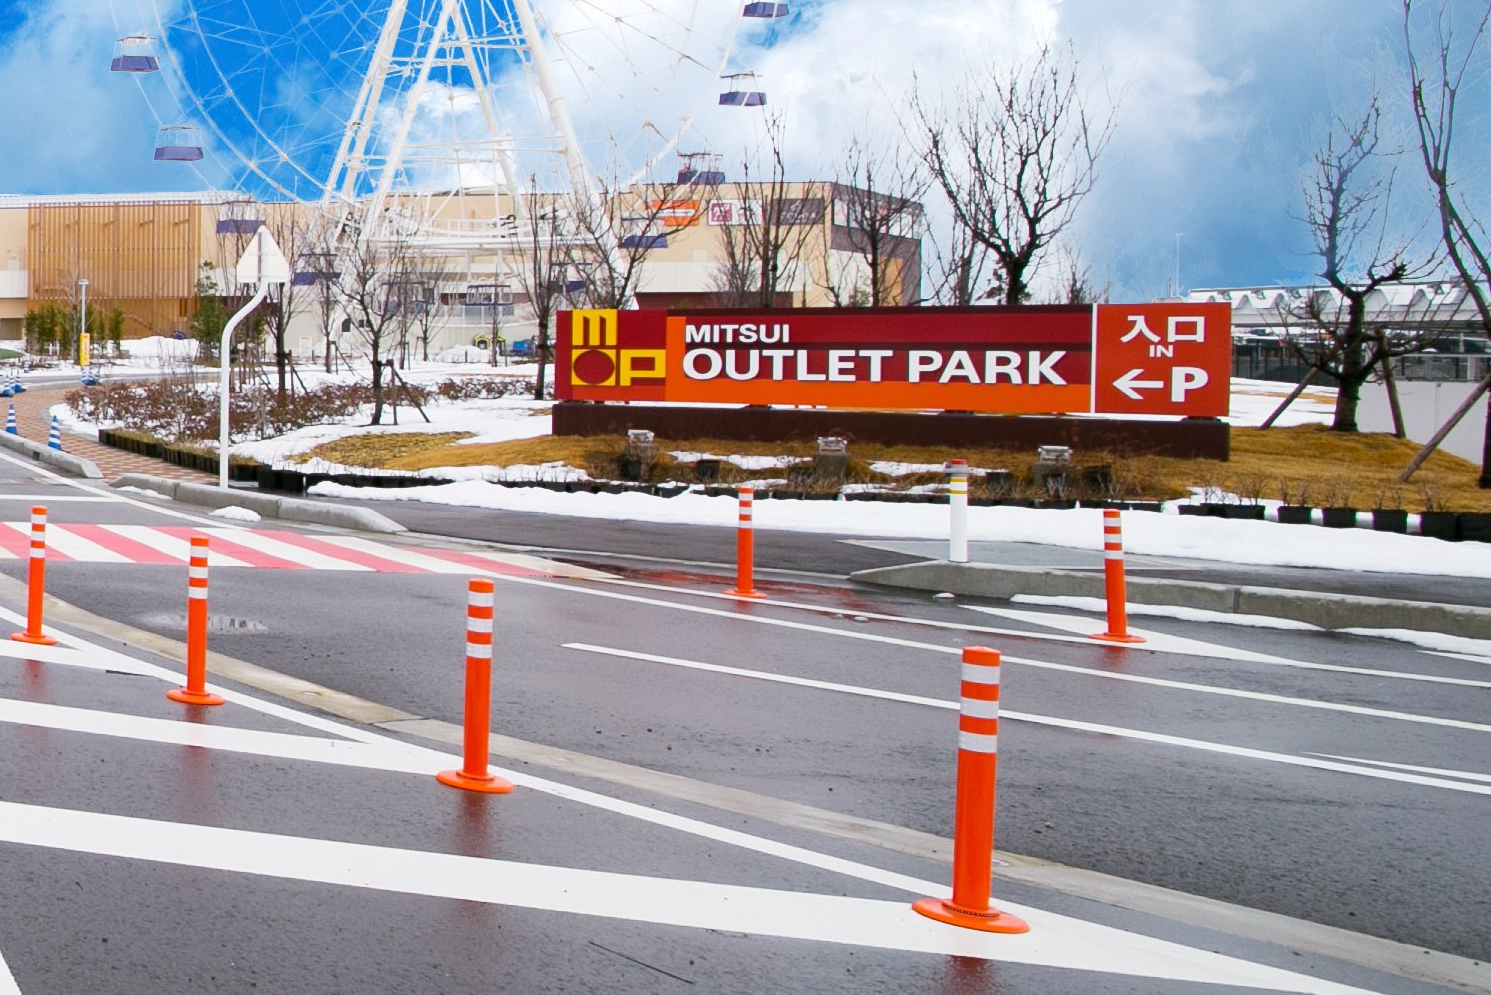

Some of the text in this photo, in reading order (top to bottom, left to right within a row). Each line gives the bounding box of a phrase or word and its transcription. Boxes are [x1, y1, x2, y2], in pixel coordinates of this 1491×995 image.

[684, 323, 791, 344] MITSUI
[1119, 315, 1206, 344] 入口
[1148, 344, 1174, 358] IN
[682, 347, 1068, 386] OUTLET PARK
[1170, 365, 1209, 403] P
